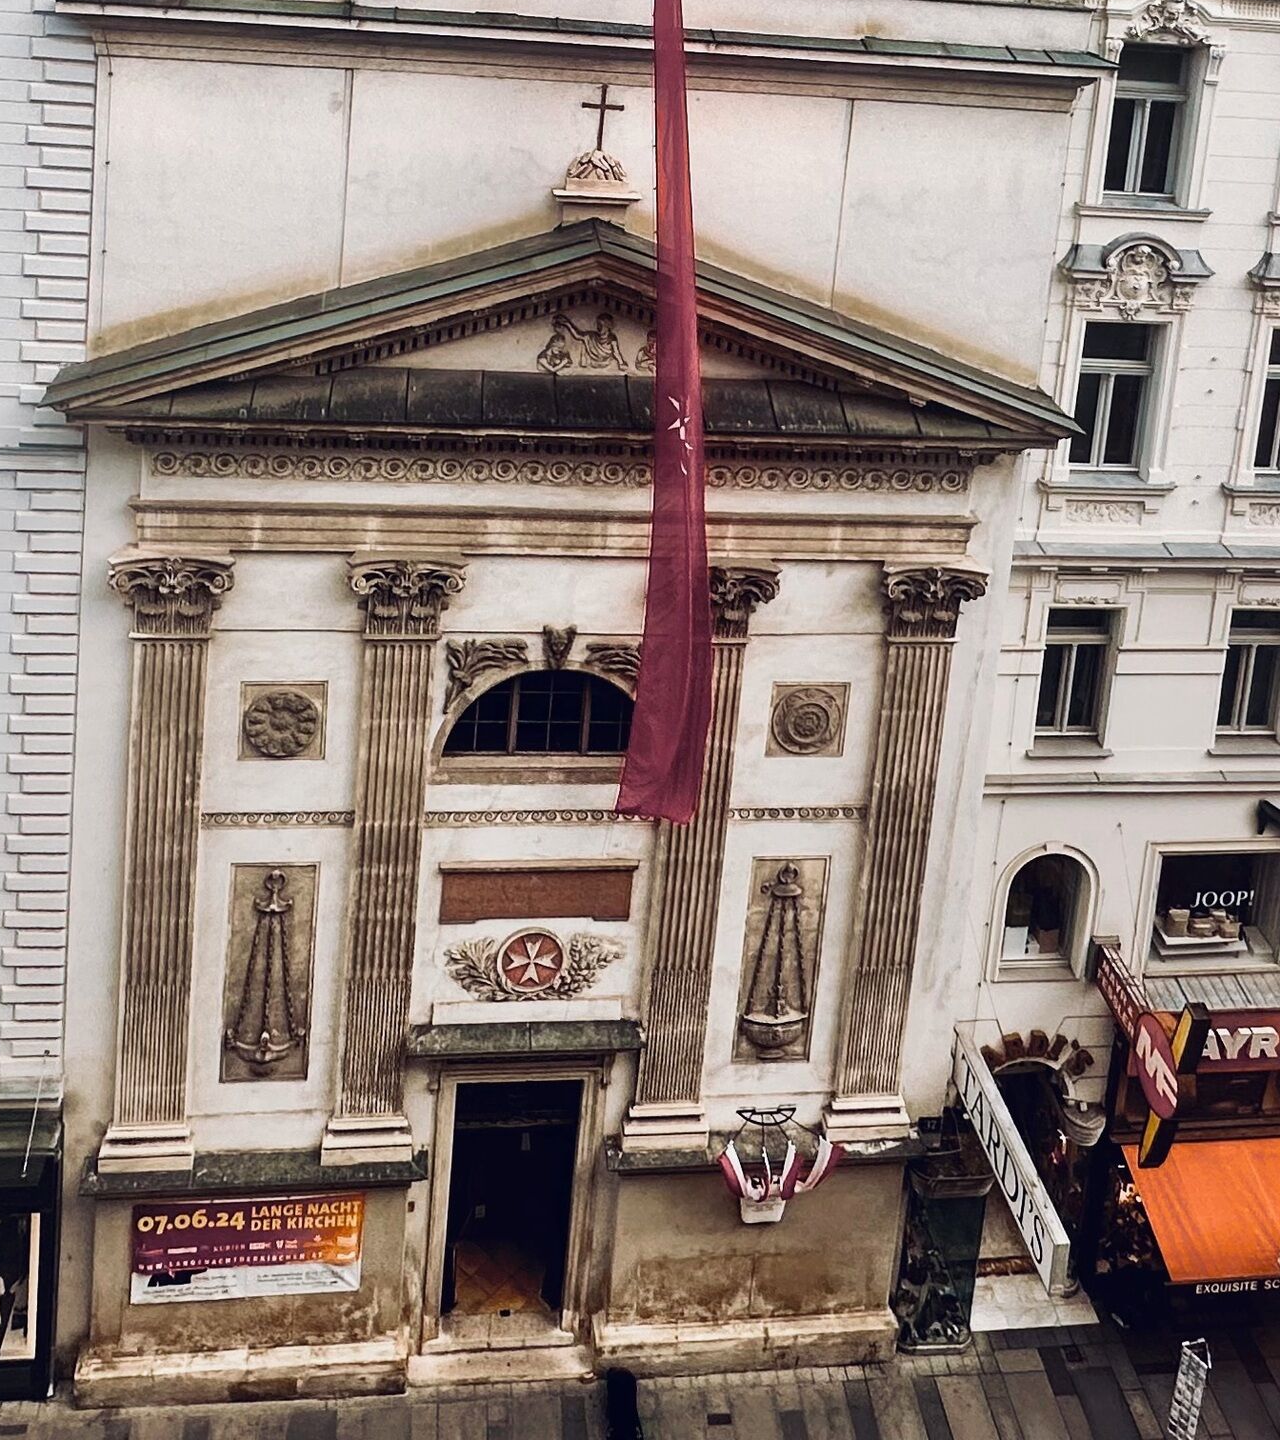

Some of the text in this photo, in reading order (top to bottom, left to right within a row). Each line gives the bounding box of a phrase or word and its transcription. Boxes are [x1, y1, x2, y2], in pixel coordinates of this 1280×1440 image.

[1190, 889, 1255, 908] JOOP!
[1200, 1026, 1280, 1060] AYR
[962, 1053, 1046, 1265] TARDI'S
[251, 1201, 361, 1218] LANGE NACHT
[137, 1209, 245, 1235] 07.06.24
[251, 1214, 358, 1232] DER KIRCHEN
[1195, 1280, 1258, 1295] EXQUISITE
